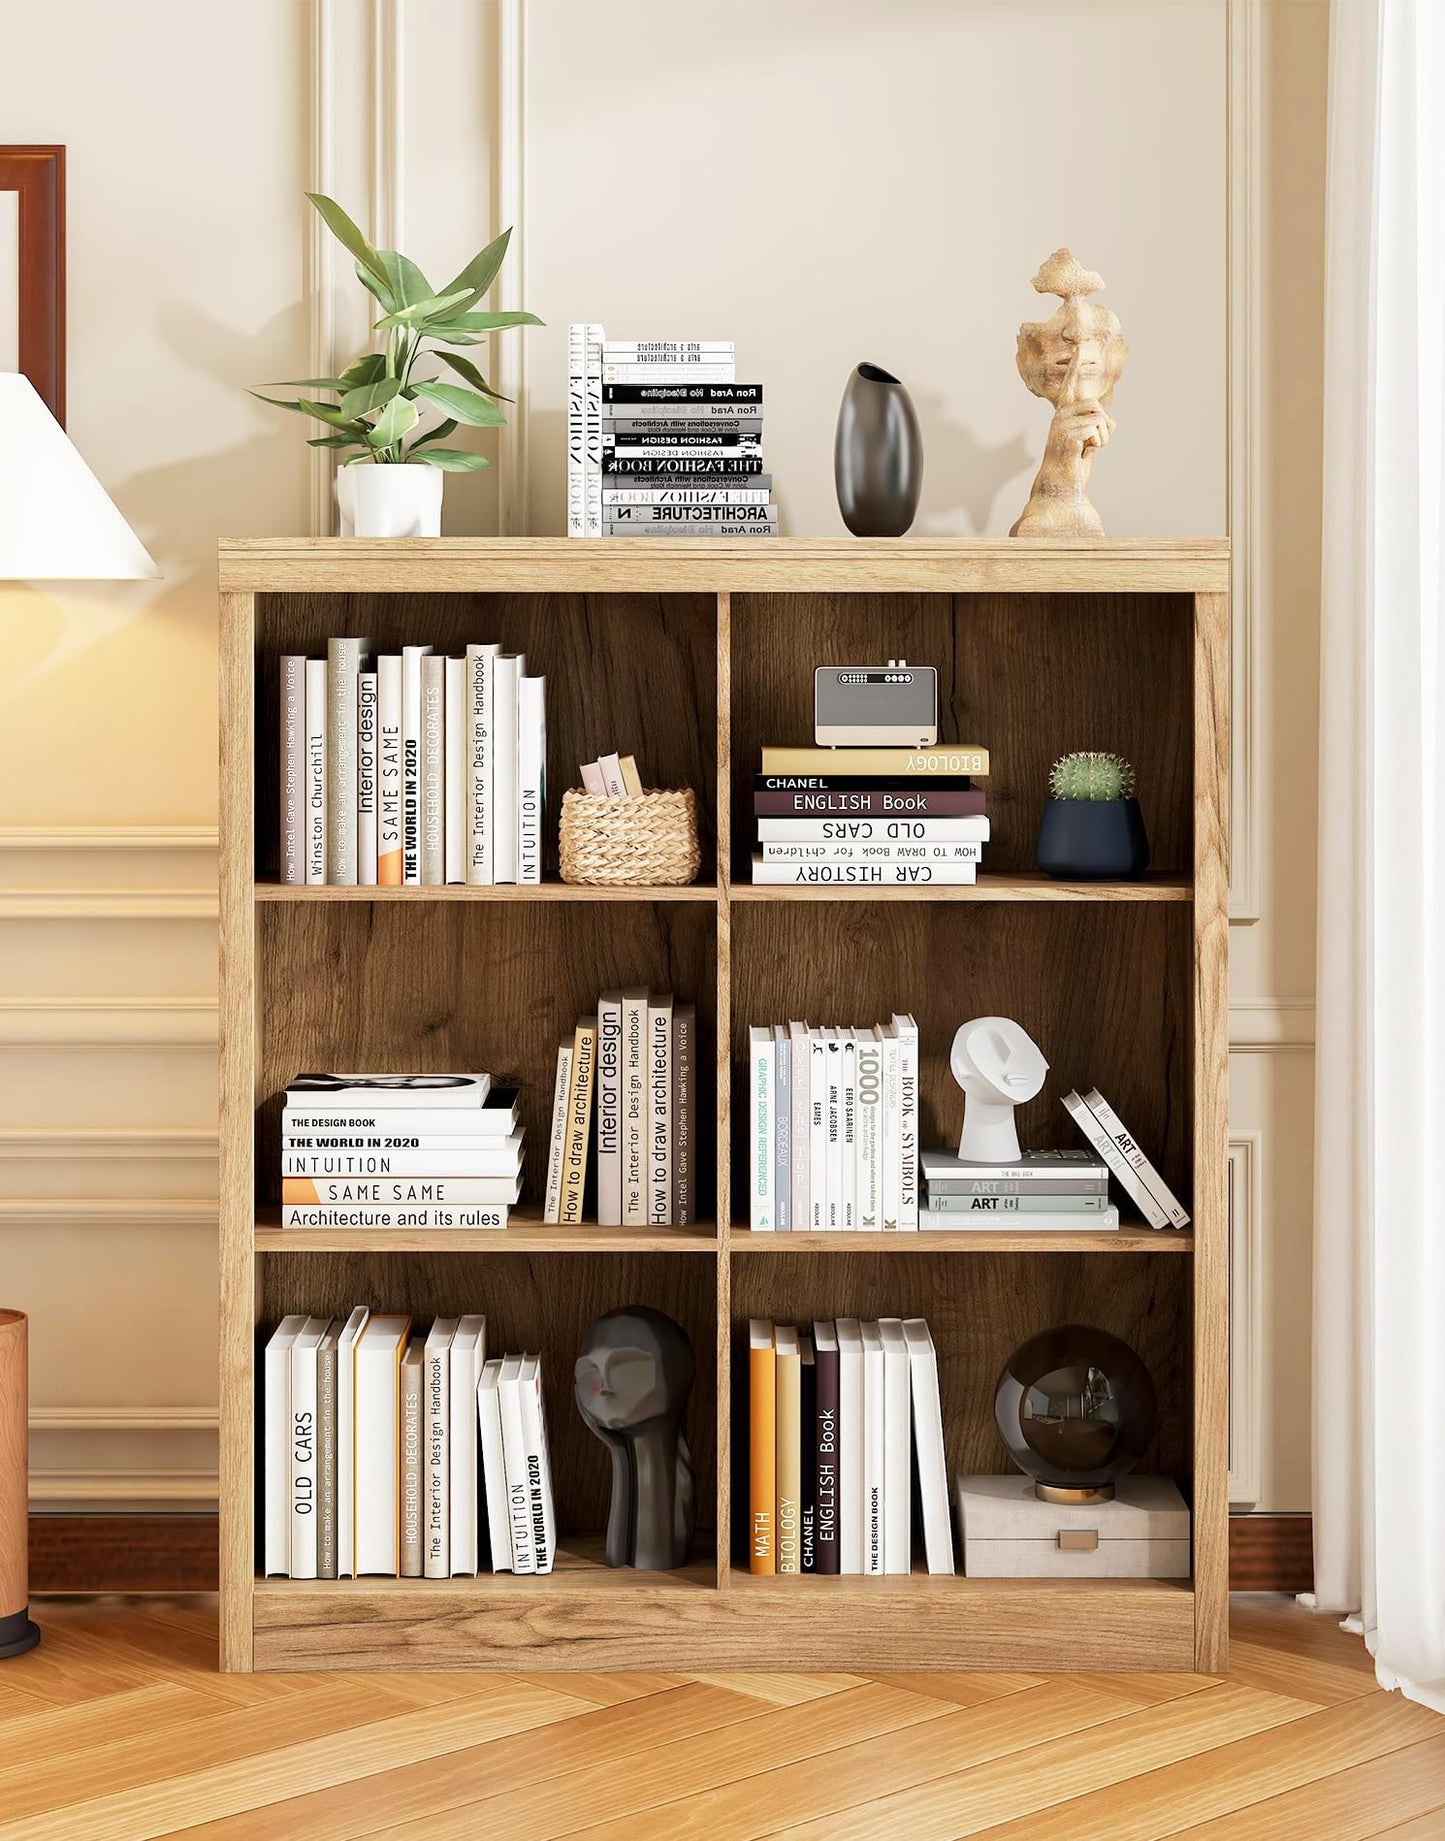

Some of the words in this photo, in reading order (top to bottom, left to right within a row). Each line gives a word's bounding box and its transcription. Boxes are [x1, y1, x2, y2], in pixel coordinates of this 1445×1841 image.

[286, 661, 296, 691] Voice
[473, 655, 484, 714] Handbook
[286, 707, 296, 748] Hawking
[358, 680, 377, 742] design
[427, 686, 439, 764] DECORATES
[383, 727, 398, 776] SAME
[405, 740, 416, 776] 2020
[473, 723, 487, 767] Design
[906, 755, 981, 771] BIOLOGY
[286, 753, 296, 794] Stephen
[311, 734, 322, 808] Churchill
[358, 748, 373, 813] Interior
[405, 781, 416, 795] IN
[767, 779, 827, 788] CHANEL
[286, 800, 296, 823] Gave
[383, 790, 398, 840] SAME
[427, 772, 439, 851] HOUSEHOLD
[473, 776, 484, 835] Interior
[795, 795, 870, 809] ENGLISH
[884, 794, 926, 809] Book
[405, 799, 416, 850] WORLD
[523, 790, 535, 879] INTUITION
[823, 823, 872, 838] CARS
[888, 823, 924, 838] OLD
[286, 830, 296, 857] Intel
[311, 817, 322, 875] Winston
[473, 844, 484, 866] The
[769, 848, 825, 857] children
[834, 848, 853, 857] for
[862, 848, 889, 856] Book
[897, 848, 925, 856] DRAW
[934, 848, 947, 857] TO
[955, 848, 976, 857] HOW
[286, 863, 296, 881] How
[405, 854, 416, 880] THE
[796, 867, 881, 881] HISTORY
[896, 867, 931, 881] CAR
[599, 1012, 620, 1078] design
[628, 1010, 639, 1067] Handbook
[678, 1024, 687, 1050] Voice
[558, 1056, 568, 1101] Handbook
[574, 1037, 592, 1124] architecture
[652, 1017, 666, 1115] architecture
[758, 1058, 767, 1098] GRAPHIC
[859, 1050, 879, 1104] 1000
[628, 1075, 642, 1118] Design
[678, 1066, 689, 1103] Hawking
[902, 1077, 913, 1117] BOOK
[292, 1119, 309, 1127] THE
[312, 1119, 346, 1127] DESIGN
[349, 1119, 375, 1127] BOOK
[556, 1107, 564, 1141] Design
[599, 1086, 616, 1153] Interior
[678, 1109, 688, 1146] Stephen
[758, 1102, 767, 1134] DESIGN
[289, 1138, 312, 1147] THE
[316, 1138, 363, 1147] WORLD
[368, 1139, 380, 1147] IN
[385, 1138, 419, 1147] 2020
[569, 1130, 583, 1166] draw
[628, 1127, 639, 1183] Interior
[652, 1122, 666, 1161] draw
[778, 1117, 786, 1166] BORDEAUX
[1115, 1133, 1136, 1154] ART
[290, 1158, 389, 1173] INTUITION
[550, 1146, 560, 1193] Interior
[567, 1171, 580, 1186] to
[652, 1168, 666, 1182] to
[679, 1152, 687, 1173] Gave
[758, 1137, 767, 1196] REFERENCED
[902, 1133, 913, 1205] SYMBOLS
[329, 1185, 379, 1200] SAME
[393, 1185, 444, 1200] SAME
[564, 1193, 577, 1222] How
[628, 1192, 639, 1213] The
[652, 1189, 666, 1224] How
[678, 1179, 686, 1204] Intel
[971, 1198, 999, 1209] ART
[290, 1210, 390, 1225] Architecture
[398, 1210, 427, 1225] and
[435, 1211, 452, 1225] its
[460, 1210, 499, 1225] rules
[324, 1351, 332, 1382] house
[324, 1387, 332, 1404] the
[430, 1358, 441, 1414] Handbook
[324, 1409, 332, 1420] in
[406, 1393, 418, 1464] DECORATES
[819, 1409, 834, 1452] Book
[295, 1413, 312, 1462] CARS
[430, 1423, 443, 1465] Design
[324, 1426, 332, 1487] arrangement
[528, 1455, 539, 1486] 2020
[295, 1477, 312, 1514] OLD
[324, 1492, 332, 1503] an
[406, 1473, 418, 1544] HOUSEHOLD
[430, 1473, 440, 1529] Interior
[530, 1489, 540, 1500] IN
[820, 1465, 834, 1540] ENGLISH
[324, 1508, 332, 1532] make
[512, 1484, 528, 1569] INTUITION
[532, 1503, 546, 1543] WORLD
[755, 1512, 770, 1556] MATH
[781, 1497, 797, 1573] BIOLOGY
[804, 1506, 813, 1567] CHANEL
[324, 1535, 332, 1546] to
[430, 1538, 440, 1559] The
[537, 1546, 547, 1570] THE
[324, 1551, 332, 1569] How
